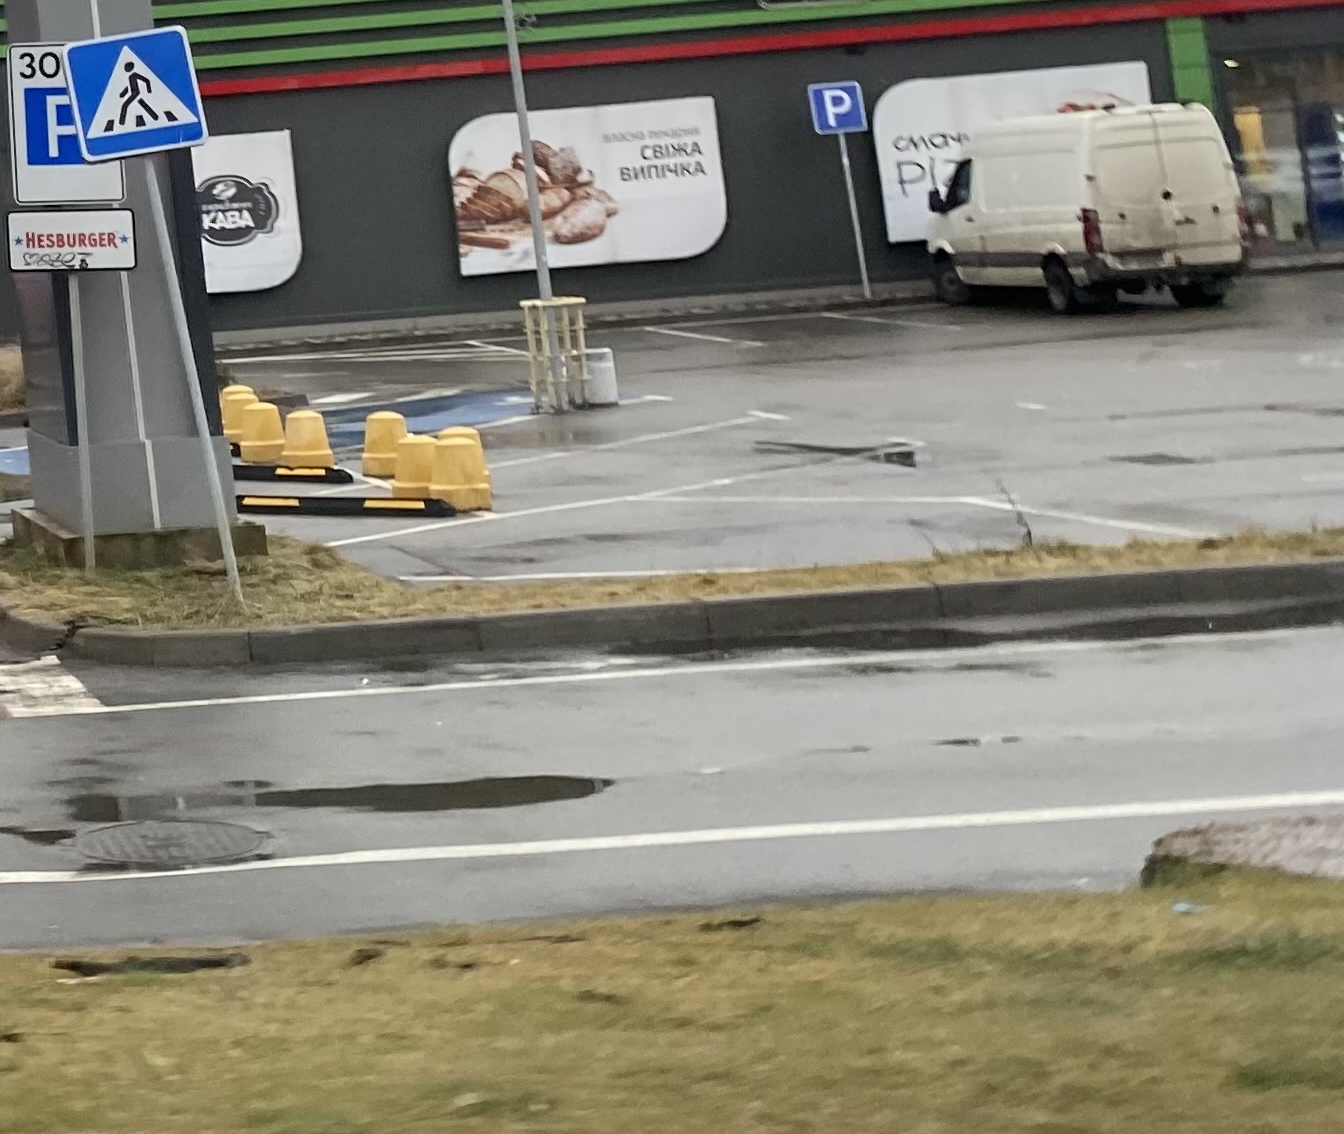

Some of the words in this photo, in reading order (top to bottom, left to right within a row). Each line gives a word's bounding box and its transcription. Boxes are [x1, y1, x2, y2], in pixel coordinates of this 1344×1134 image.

[822, 88, 853, 128] P
[640, 141, 703, 160] СВІЖА
[619, 161, 707, 182] ВИПІЧКА
[25, 231, 119, 250] HESBURGER
